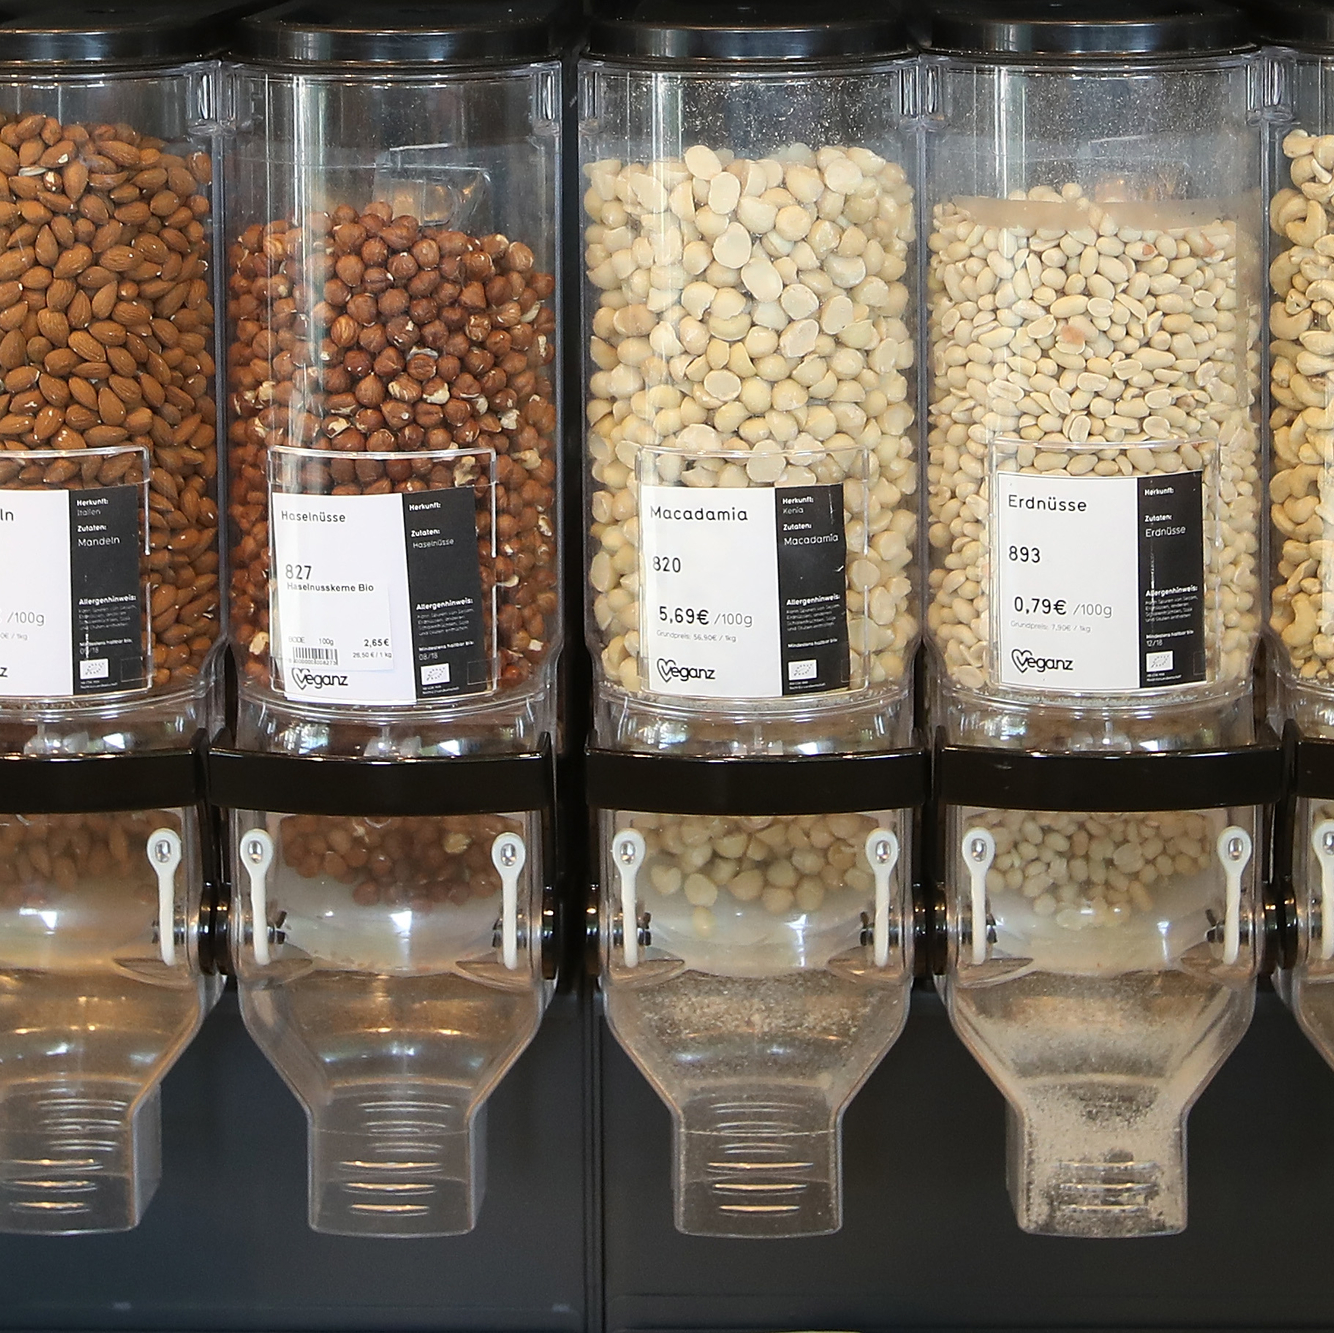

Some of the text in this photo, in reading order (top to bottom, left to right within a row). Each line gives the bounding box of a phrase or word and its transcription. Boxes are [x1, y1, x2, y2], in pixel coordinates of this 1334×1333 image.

[1008, 494, 1088, 512] Erdnüsse
[281, 511, 346, 523] Haselnüsse
[650, 506, 748, 521] Macadamia
[784, 532, 839, 545] Macadamia
[1146, 526, 1186, 537] Erdnüsse
[78, 537, 120, 547] Mandeln
[1009, 546, 1041, 563] 893
[285, 564, 312, 580] 827
[653, 556, 681, 573] 820
[358, 583, 374, 592] Bio
[1014, 596, 1112, 618] 0,79€ /100g
[6, 612, 45, 627] /100g
[659, 606, 753, 627] 5,69€ /100g
[1011, 649, 1074, 673] Veganz
[656, 657, 716, 683] Veganz
